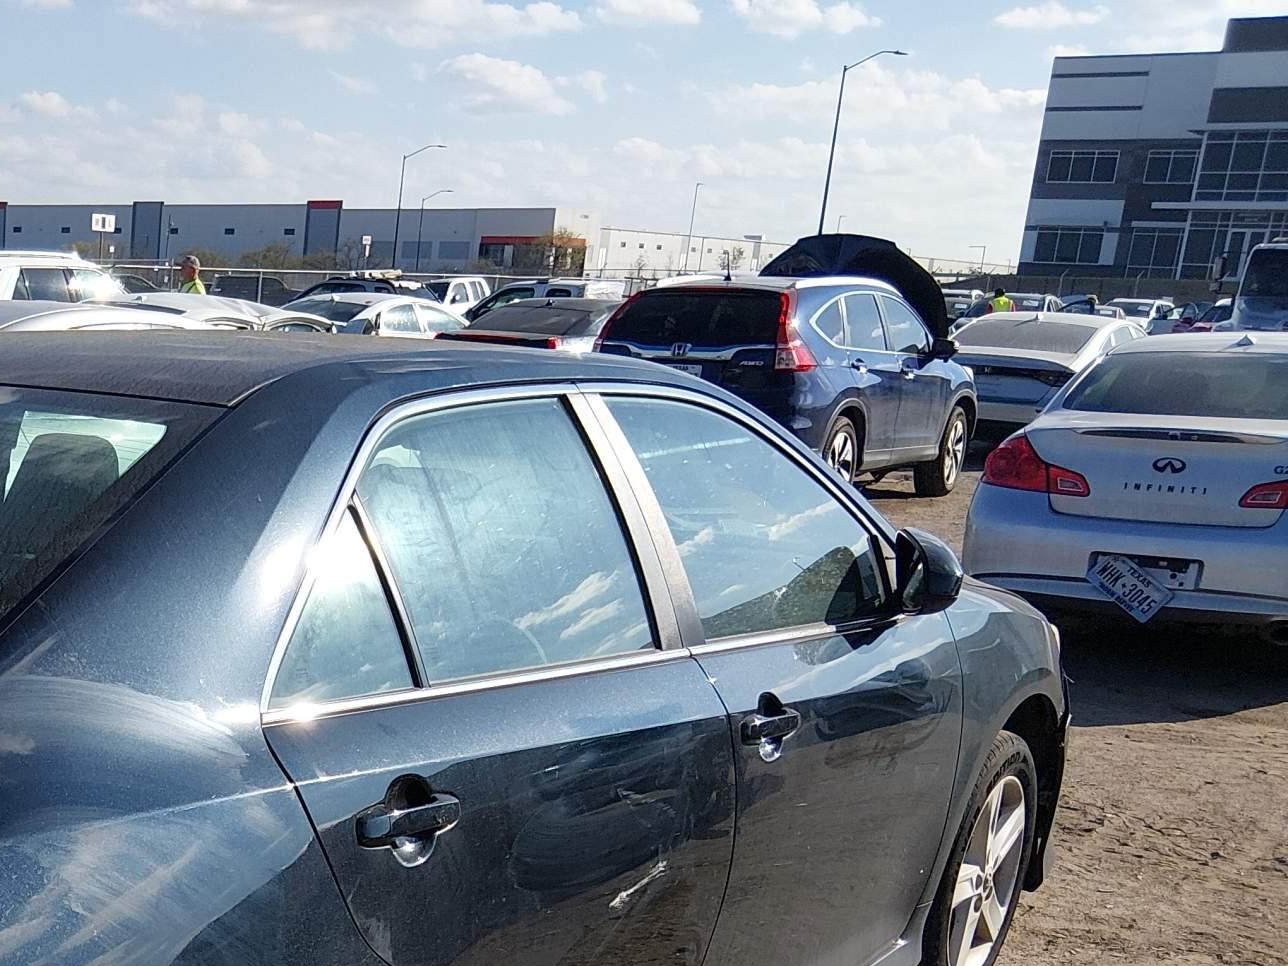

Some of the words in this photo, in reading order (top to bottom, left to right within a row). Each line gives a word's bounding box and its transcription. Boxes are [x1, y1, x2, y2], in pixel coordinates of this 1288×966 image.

[1123, 482, 1208, 495] INFINITI
[1127, 566, 1153, 588] TEXAS
[1122, 583, 1158, 614] 3045
